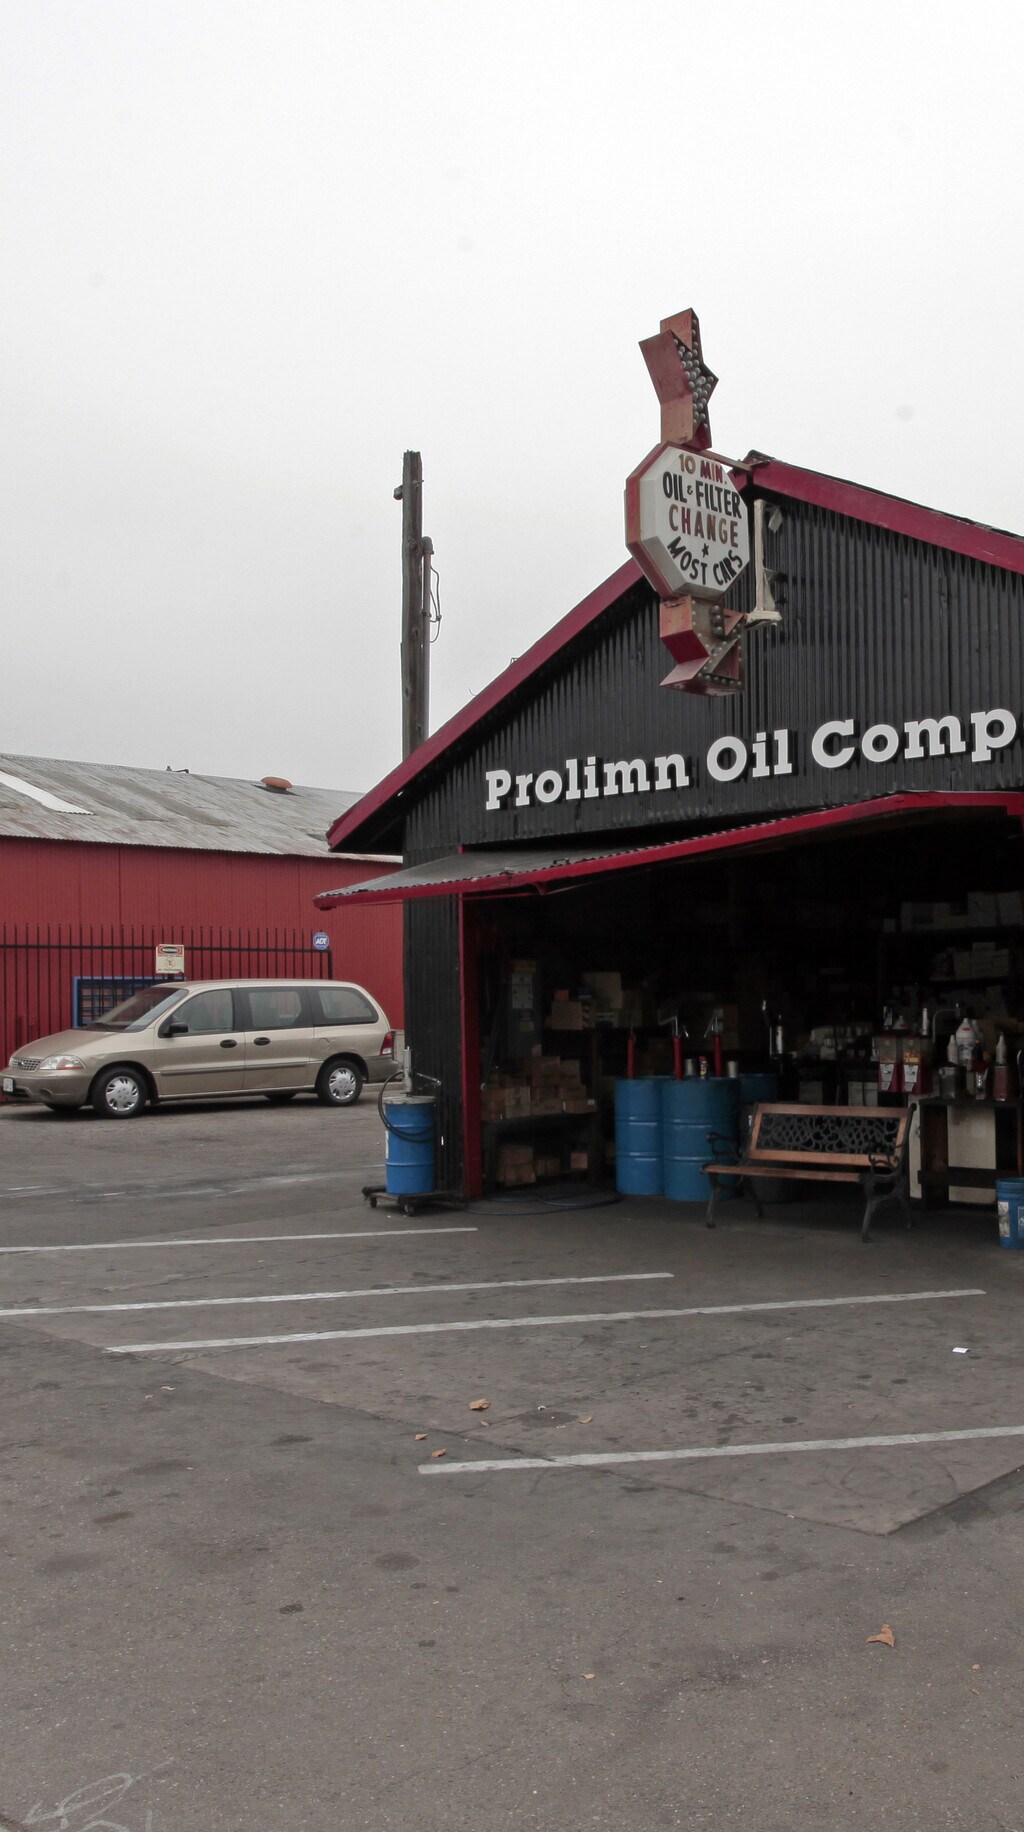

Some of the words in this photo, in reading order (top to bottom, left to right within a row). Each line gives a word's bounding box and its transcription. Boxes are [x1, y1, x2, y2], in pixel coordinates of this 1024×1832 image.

[678, 453, 696, 475] 10
[701, 460, 727, 484] MIN.
[663, 471, 687, 503] OIL
[695, 480, 742, 519] FILTER
[669, 504, 738, 548] CHANGE
[667, 536, 708, 585] MOST
[713, 550, 743, 586] CARS
[485, 753, 690, 811] Prolimn
[706, 729, 793, 782] Oil
[315, 937, 327, 945] ADT
